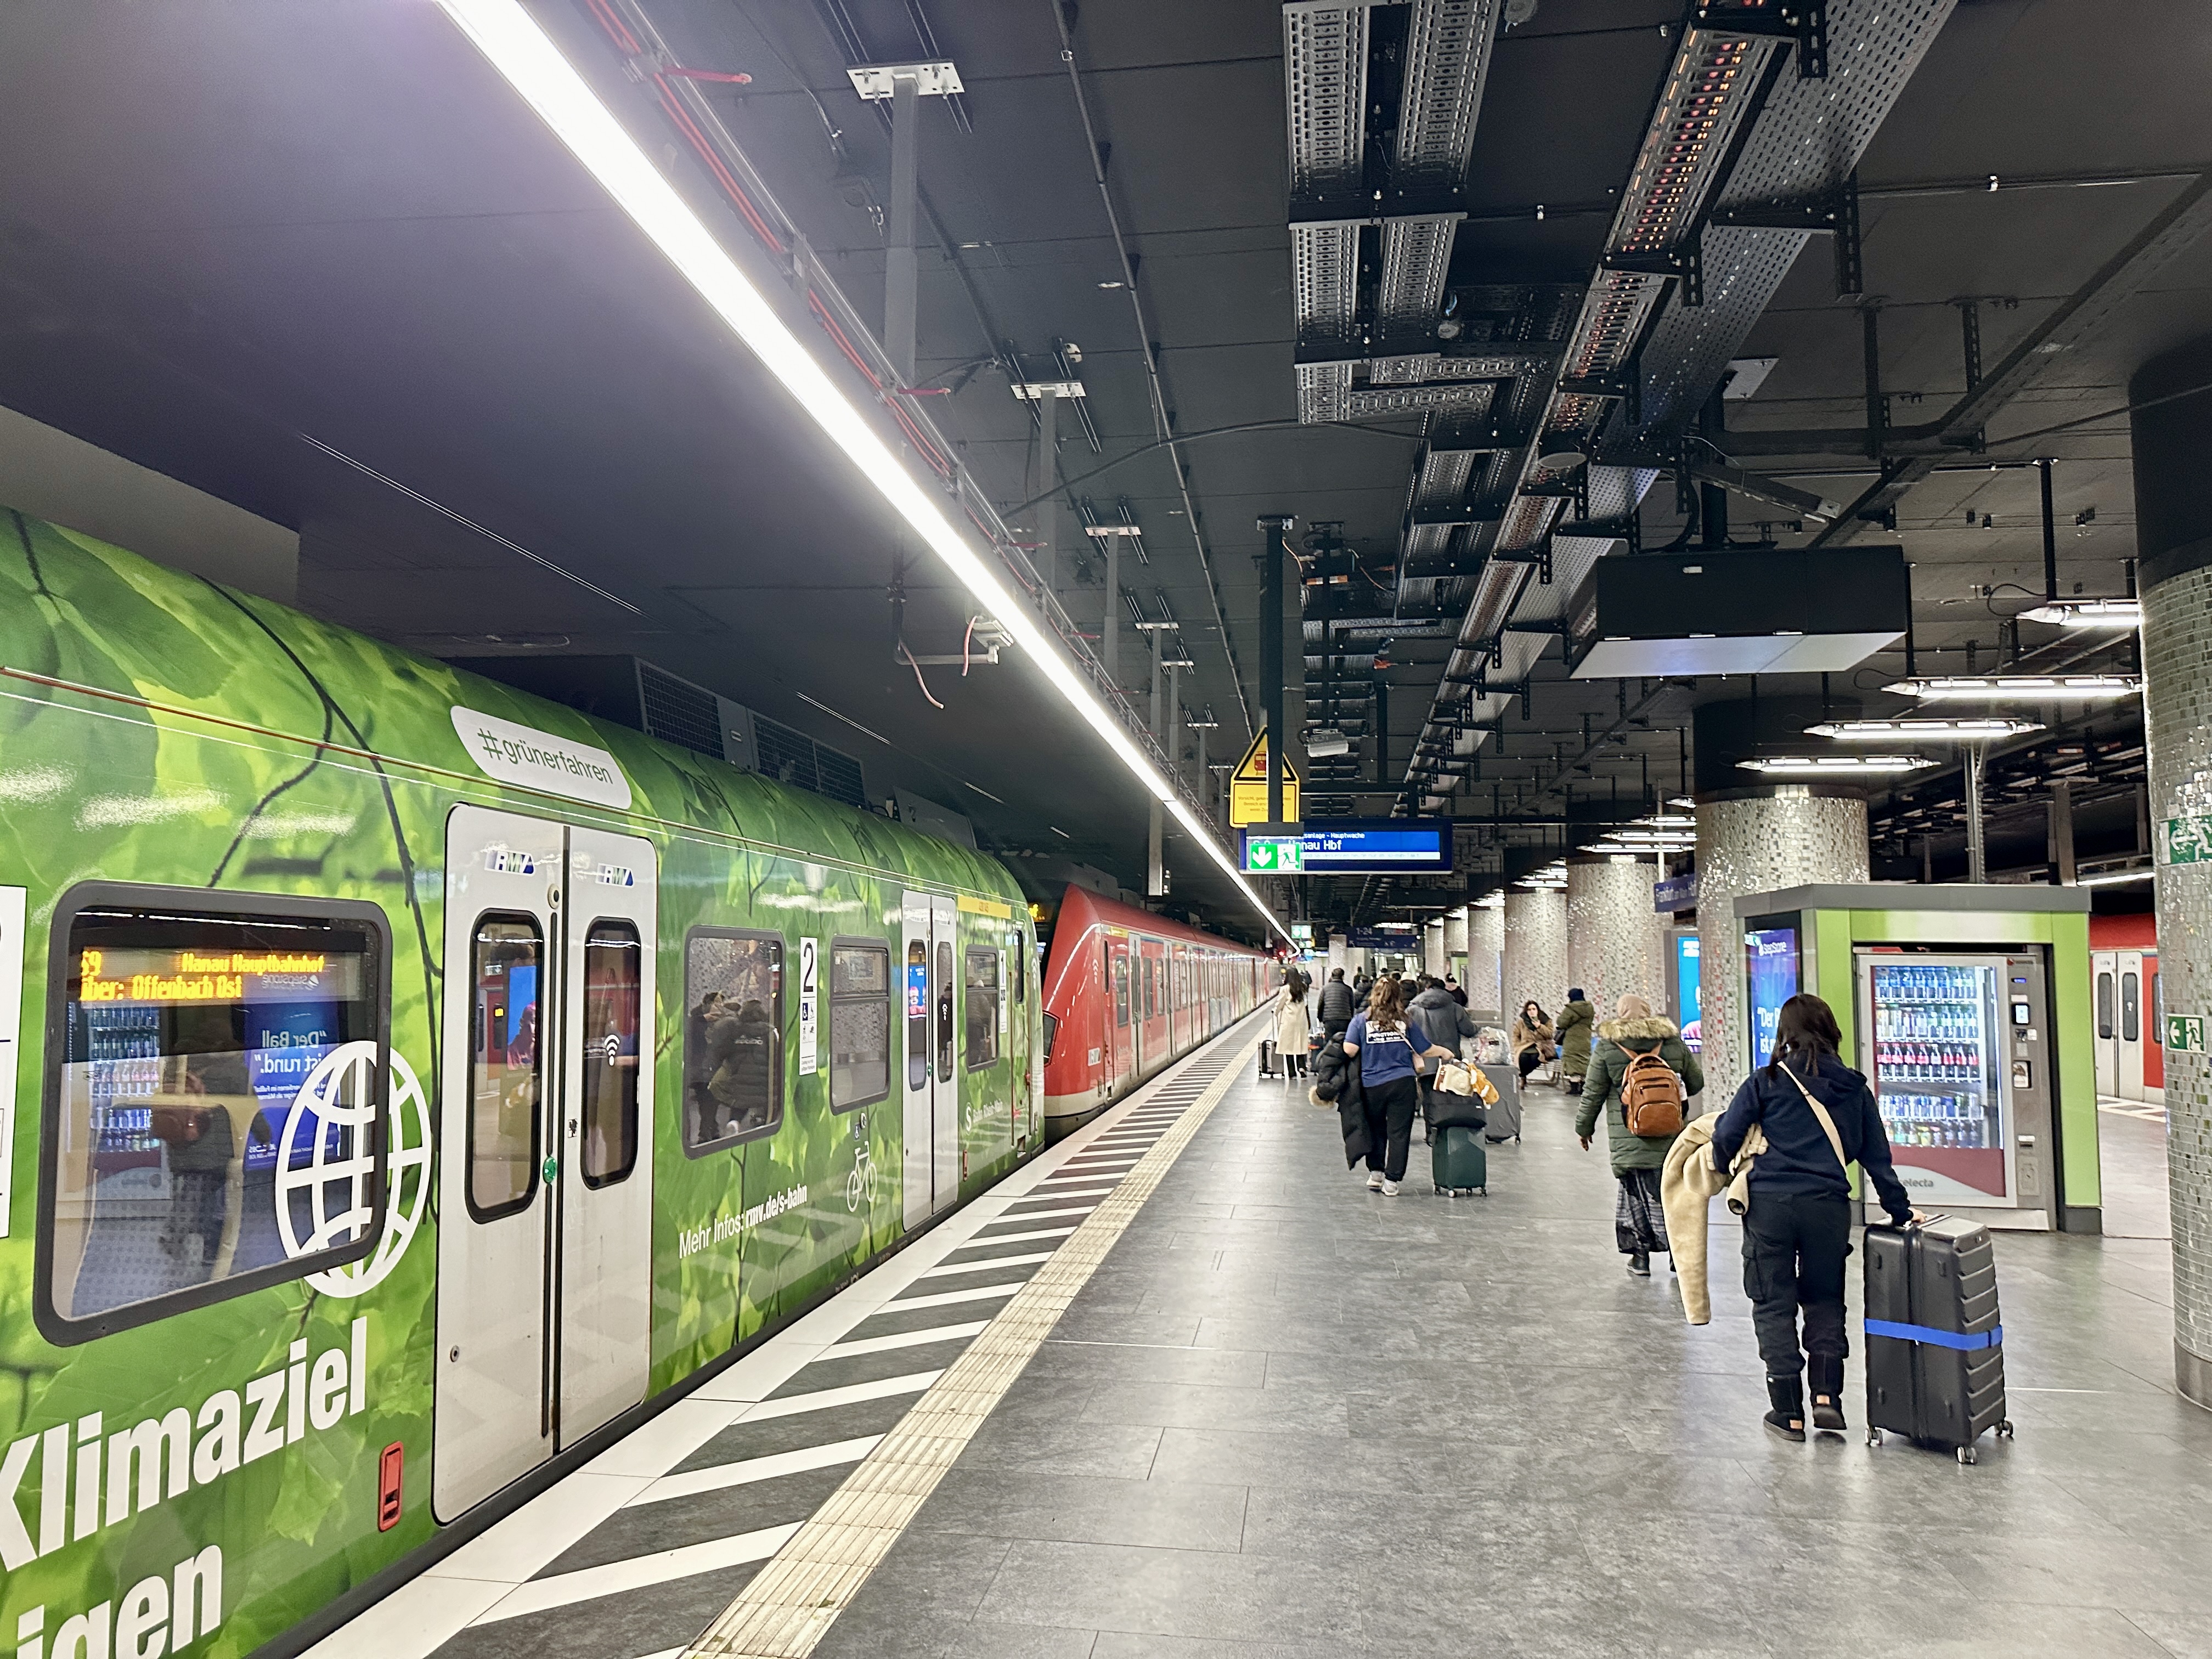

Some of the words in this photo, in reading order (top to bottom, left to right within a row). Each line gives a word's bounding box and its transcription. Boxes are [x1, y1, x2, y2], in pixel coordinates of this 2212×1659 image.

[477, 728, 614, 784] #grünerfahren
[1323, 840, 1342, 850] Hbf
[494, 851, 533, 874] RMV
[603, 866, 632, 885] RMV
[182, 953, 229, 972] Hanau
[232, 953, 324, 976] Hauptbahnhof
[803, 942, 814, 992] 2
[132, 975, 213, 1000] Offenbach
[216, 975, 242, 998] Ost
[1899, 1178, 1934, 1187] electa
[679, 1224, 711, 1259] Mehr
[714, 1214, 744, 1243] Infos:
[746, 1183, 808, 1228] rmv.de/s-bahn
[0, 1316, 367, 1572] Klimaziel
